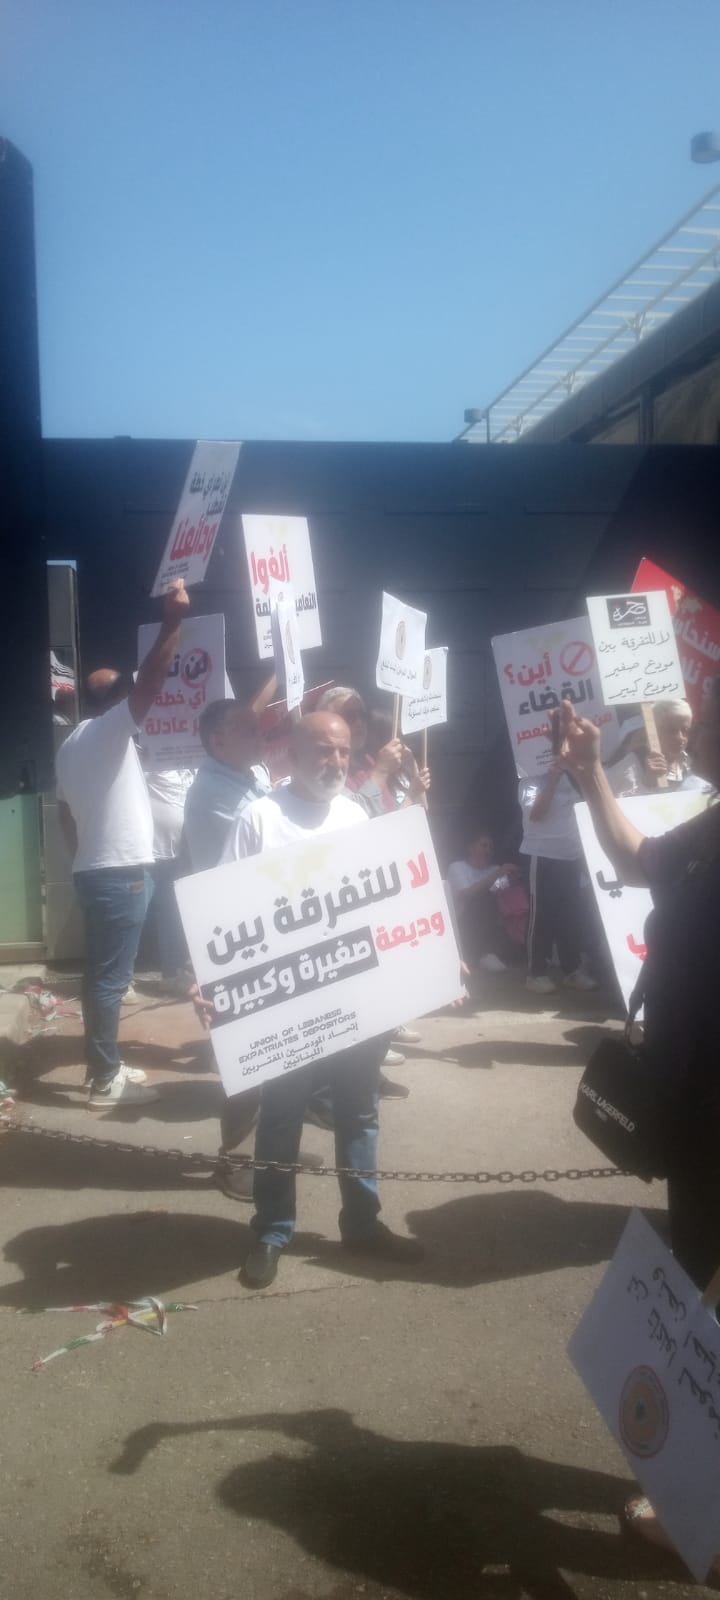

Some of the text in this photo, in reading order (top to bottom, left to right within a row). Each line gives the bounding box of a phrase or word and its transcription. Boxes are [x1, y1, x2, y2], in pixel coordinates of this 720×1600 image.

[170, 513, 217, 562] ودائعنا
[251, 544, 290, 594] ألغوا
[599, 642, 617, 655] بين
[519, 678, 594, 716] القضاء
[146, 717, 188, 736] عادلة
[206, 851, 430, 966] لا للتفرقة بين
[213, 911, 445, 1016] وديعة صغيرة وكبيرة
[238, 1012, 357, 1064] EXPATRIATES DEPOSITORS
[249, 1008, 342, 1050] UNION OF LEBANESE
[580, 1082, 598, 1103] KARL
[597, 1097, 635, 1132] LAGERFELD
